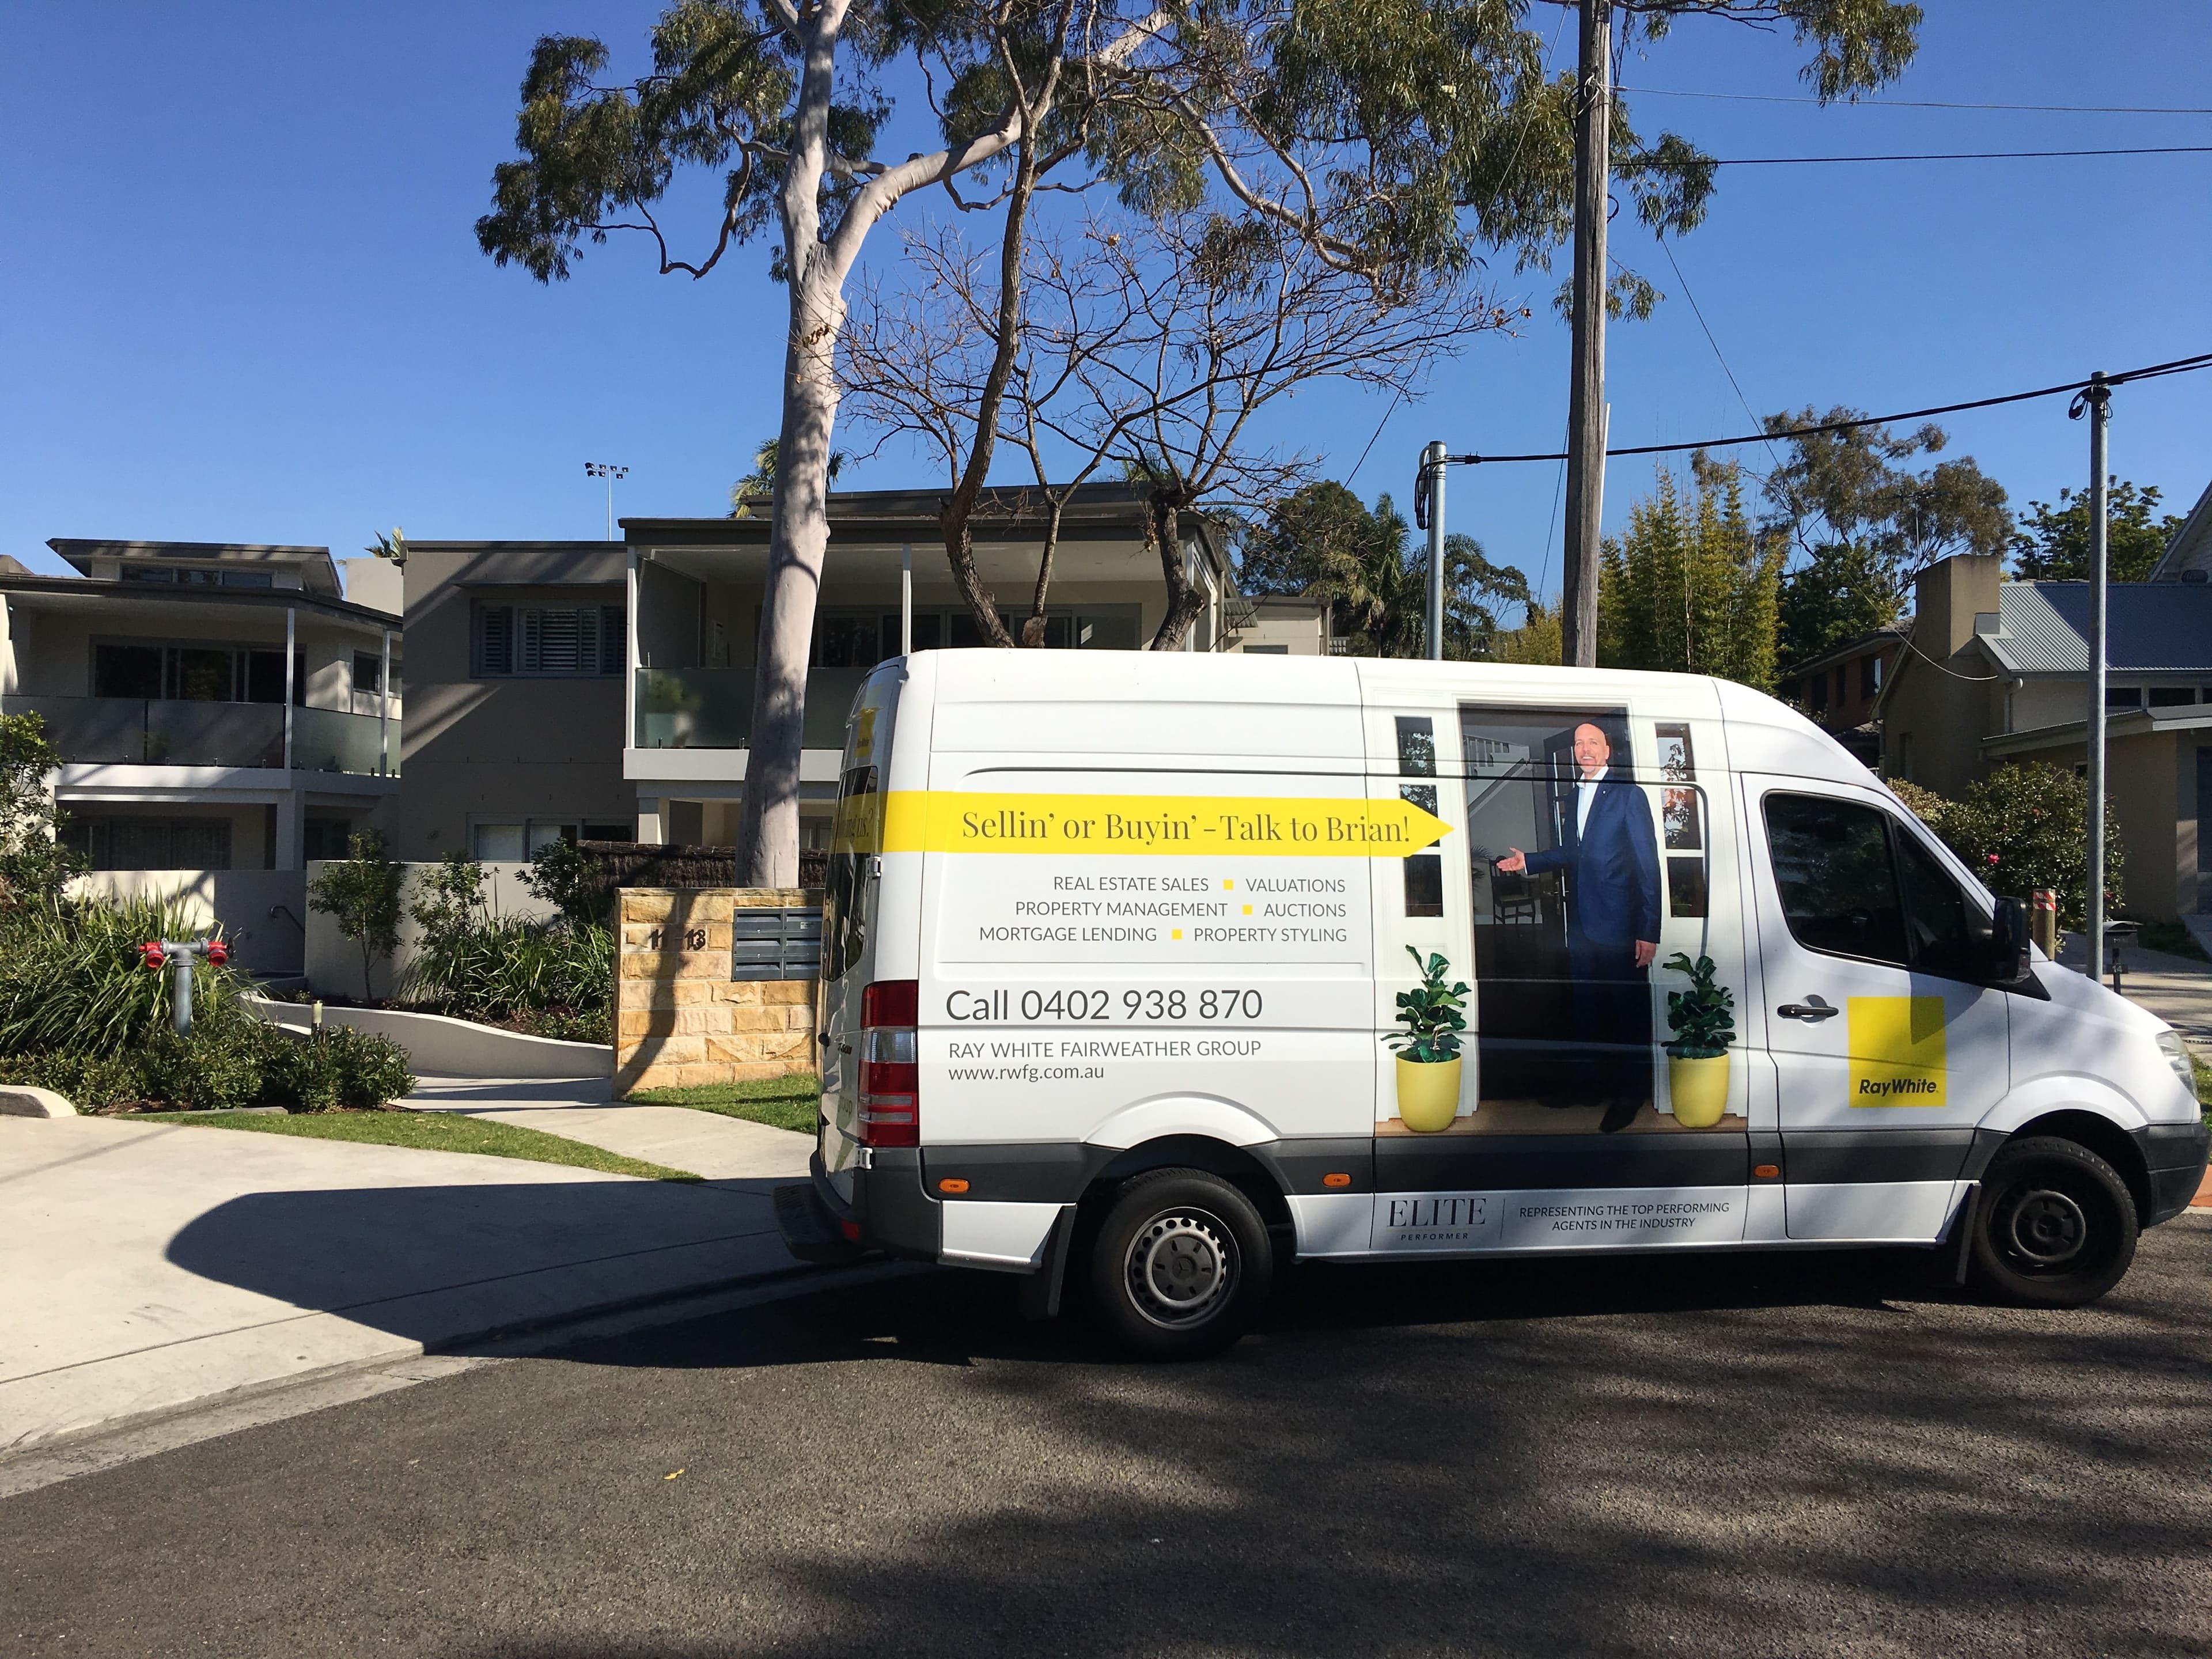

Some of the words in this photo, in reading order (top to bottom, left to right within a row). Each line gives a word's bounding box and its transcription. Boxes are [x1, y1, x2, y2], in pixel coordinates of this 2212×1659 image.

[963, 810, 1054, 838] Sellin'
[1063, 820, 1096, 839] or
[1105, 813, 1196, 846] Buyin'
[1291, 818, 1317, 842] to
[1326, 816, 1410, 842] Brian!
[1054, 876, 1095, 891] REAL
[1099, 877, 1157, 891] ESTATE
[1161, 877, 1209, 892] SALES
[1245, 878, 1346, 893] VALUATIONS
[1016, 902, 1103, 916] PROPERTY
[1107, 902, 1228, 916] MANAGEMENT
[1263, 903, 1346, 918] AUCTIONS
[980, 927, 1077, 941] MORTGAGE
[1082, 927, 1157, 942] LENDING
[1194, 927, 1277, 942] PROPERTY
[1281, 927, 1347, 942] STYLING
[946, 989, 1008, 1021] Call
[1021, 990, 1110, 1020] 0402
[1123, 990, 1187, 1020] 938
[1199, 989, 1263, 1020] 870
[949, 1042, 985, 1058] RAY
[990, 1042, 1054, 1058] WHITE
[1061, 1041, 1191, 1058] FAIRWEATHER
[1197, 1040, 1261, 1056] GROUP
[948, 1063, 1104, 1082] www.rwfg.com.au
[1387, 1198, 1487, 1227] ELITE
[1520, 1206, 1604, 1217] REPRESENTING
[1606, 1205, 1630, 1215] THE
[1631, 1204, 1654, 1215] TOP
[1656, 1202, 1730, 1214] PERFORMING
[1552, 1220, 1597, 1231] AGENTS
[1600, 1219, 1613, 1230] IN
[1615, 1219, 1637, 1229] THE
[1639, 1217, 1696, 1228] INDUSTRY
[1400, 1232, 1469, 1241] PERFORMER
